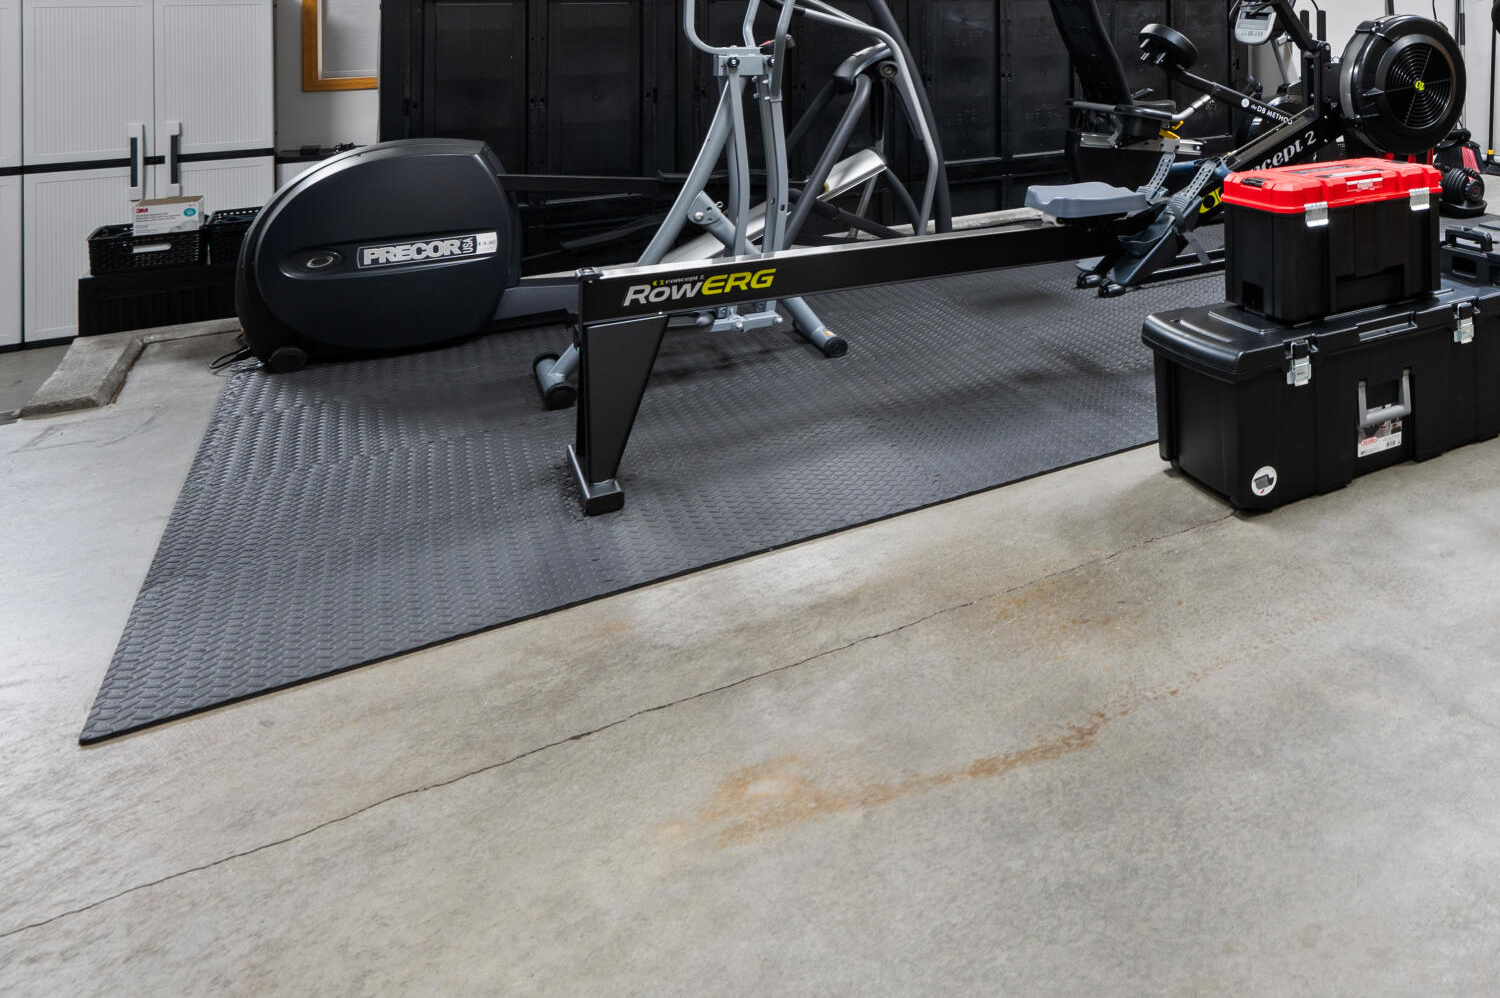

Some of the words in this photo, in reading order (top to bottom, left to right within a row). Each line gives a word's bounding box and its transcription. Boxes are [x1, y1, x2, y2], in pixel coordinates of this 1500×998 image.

[1257, 105, 1266, 114] DB
[1250, 140, 1303, 171] cept
[1304, 130, 1317, 146] 2
[363, 239, 462, 265] PRECOR
[462, 237, 474, 254] USA
